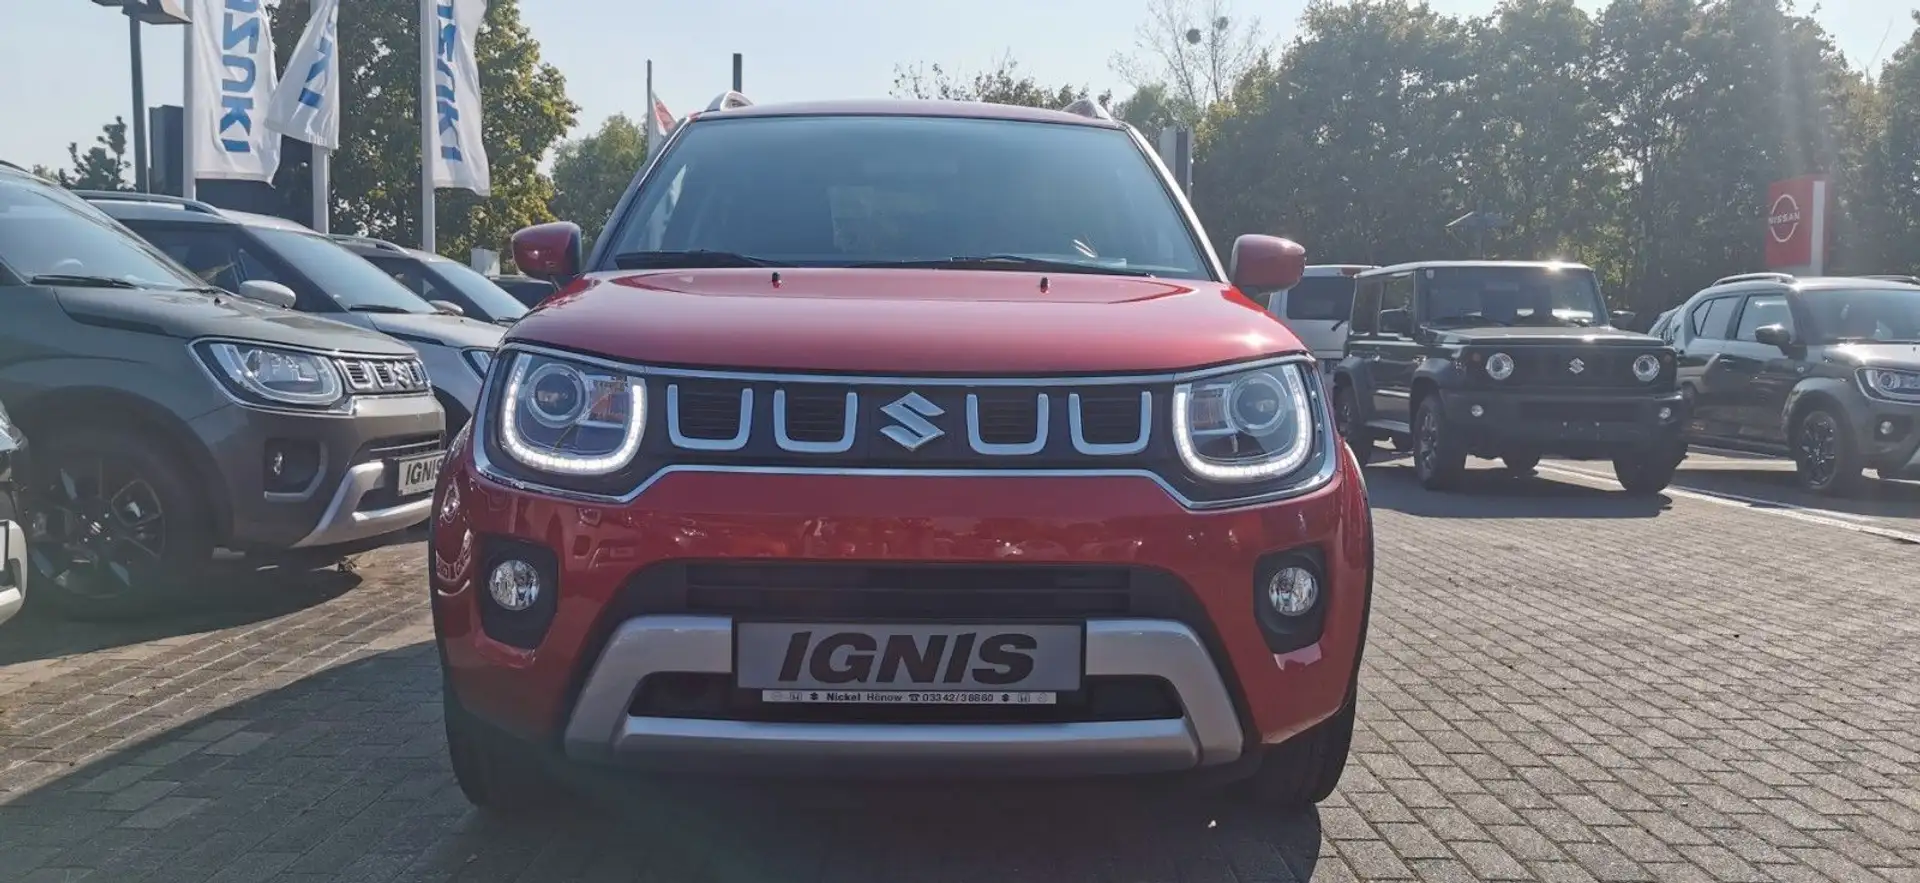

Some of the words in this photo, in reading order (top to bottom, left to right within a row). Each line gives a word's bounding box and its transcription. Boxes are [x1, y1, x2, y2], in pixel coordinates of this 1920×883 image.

[1768, 211, 1800, 224] NISSAN
[778, 631, 1037, 685] IGNIS
[826, 692, 861, 701] Nickel
